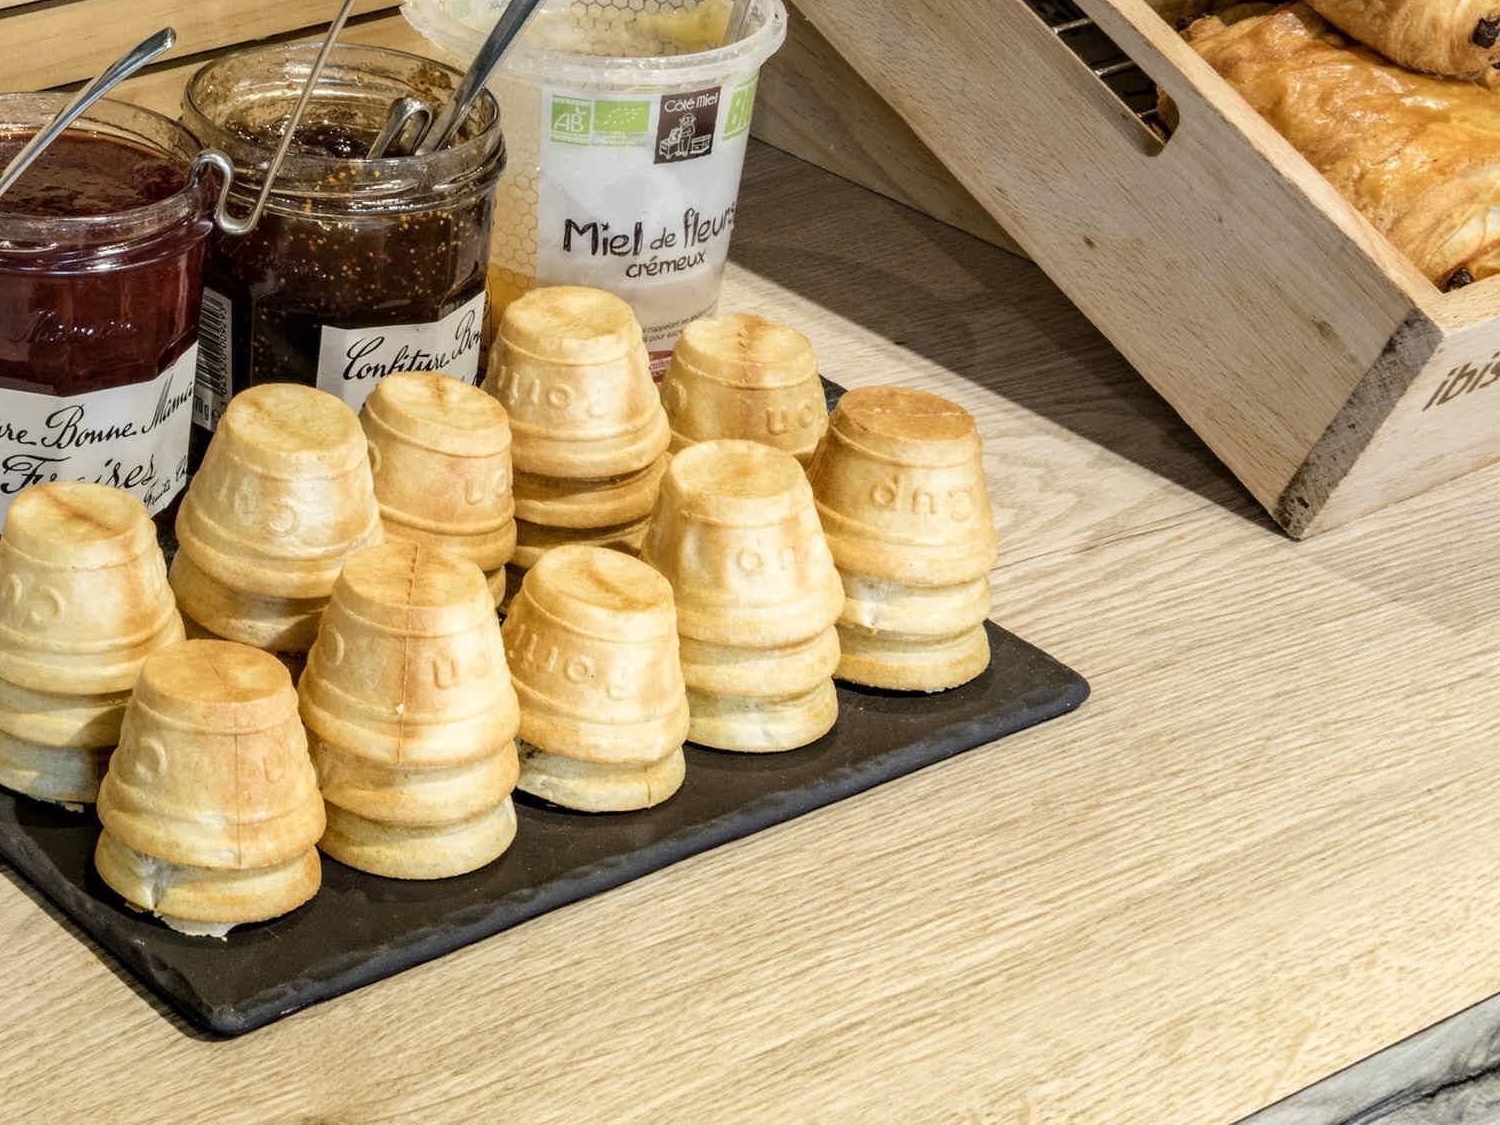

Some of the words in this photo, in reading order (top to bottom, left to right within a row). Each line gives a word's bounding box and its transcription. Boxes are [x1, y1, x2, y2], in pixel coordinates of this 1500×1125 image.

[553, 111, 585, 133] AB
[563, 217, 644, 257] Miel
[650, 227, 677, 251] de
[625, 251, 707, 279] crémeux
[41, 404, 137, 449] Bonne
